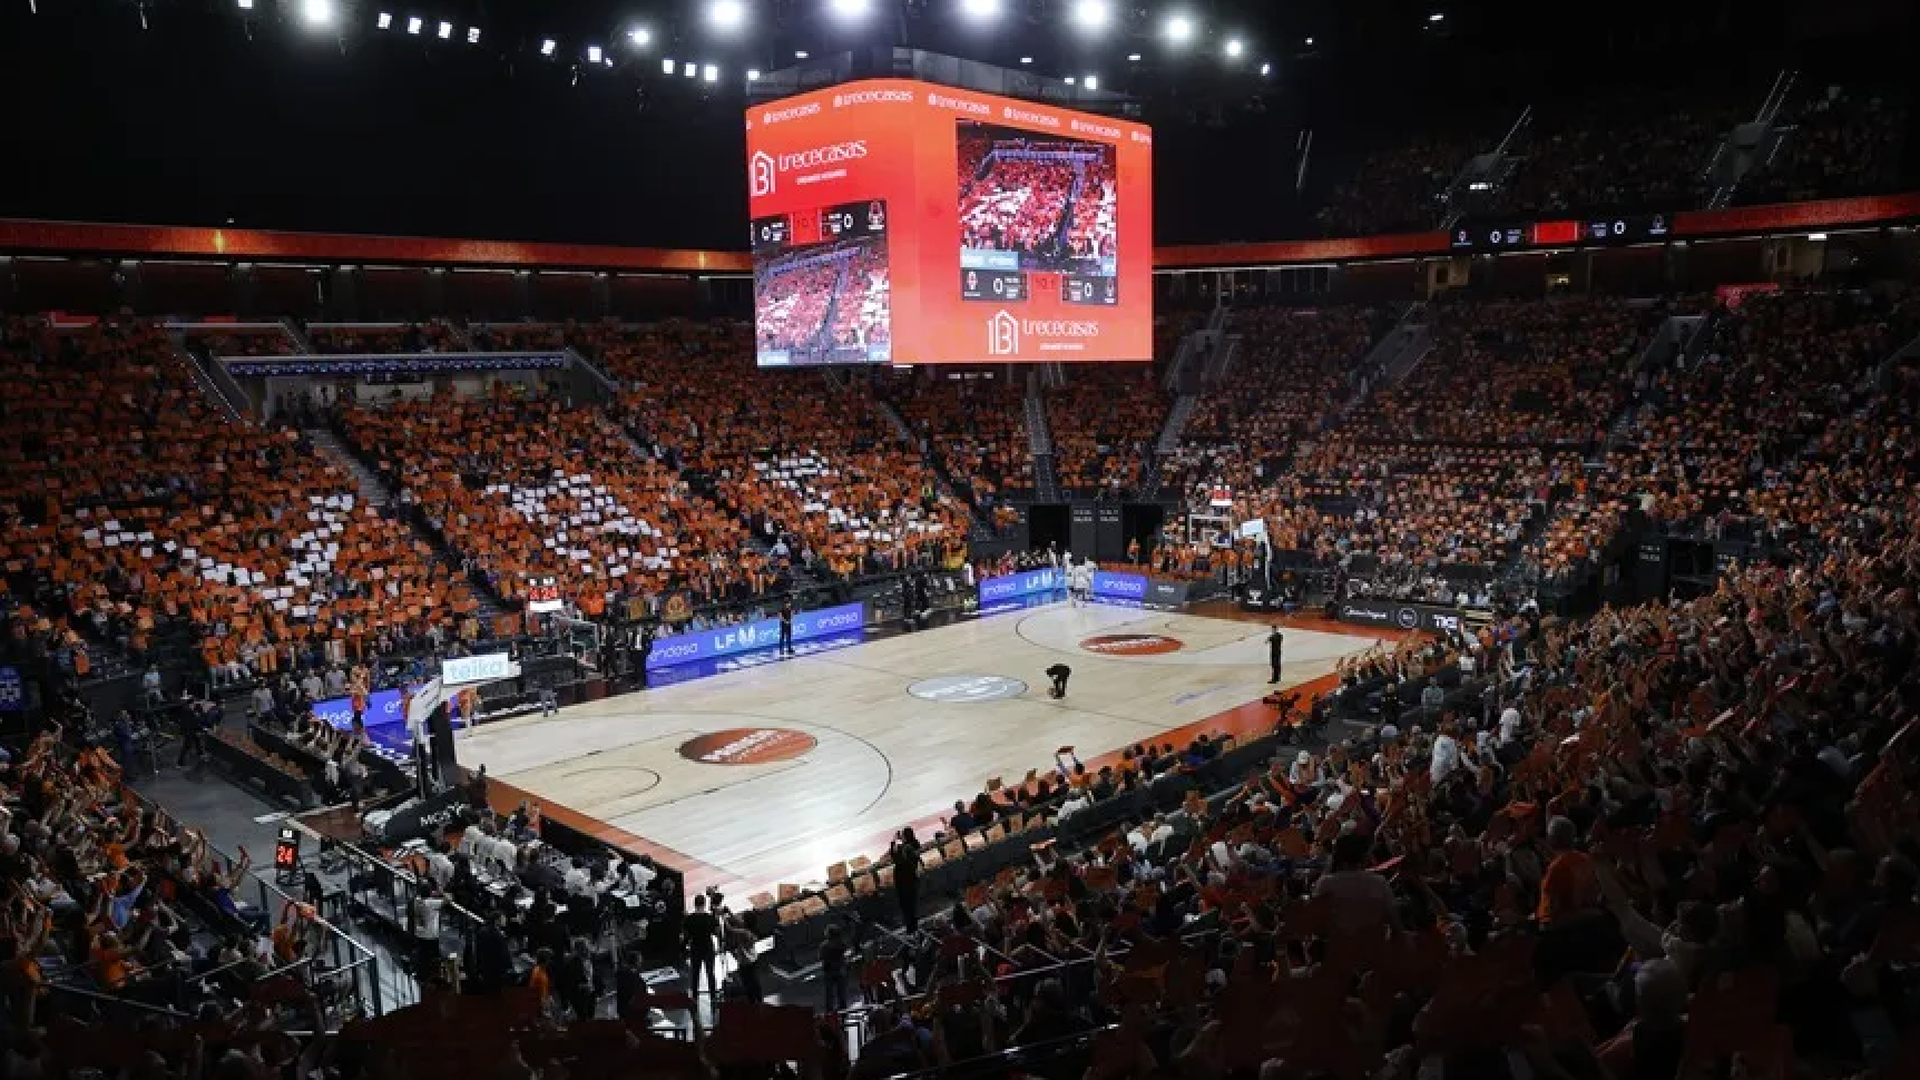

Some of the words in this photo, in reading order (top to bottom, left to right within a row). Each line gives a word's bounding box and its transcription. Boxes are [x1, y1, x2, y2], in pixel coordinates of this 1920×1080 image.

[778, 139, 868, 172] trececasas
[1022, 318, 1099, 337] trececasas
[647, 642, 698, 662] endesa
[816, 611, 859, 629] endesa
